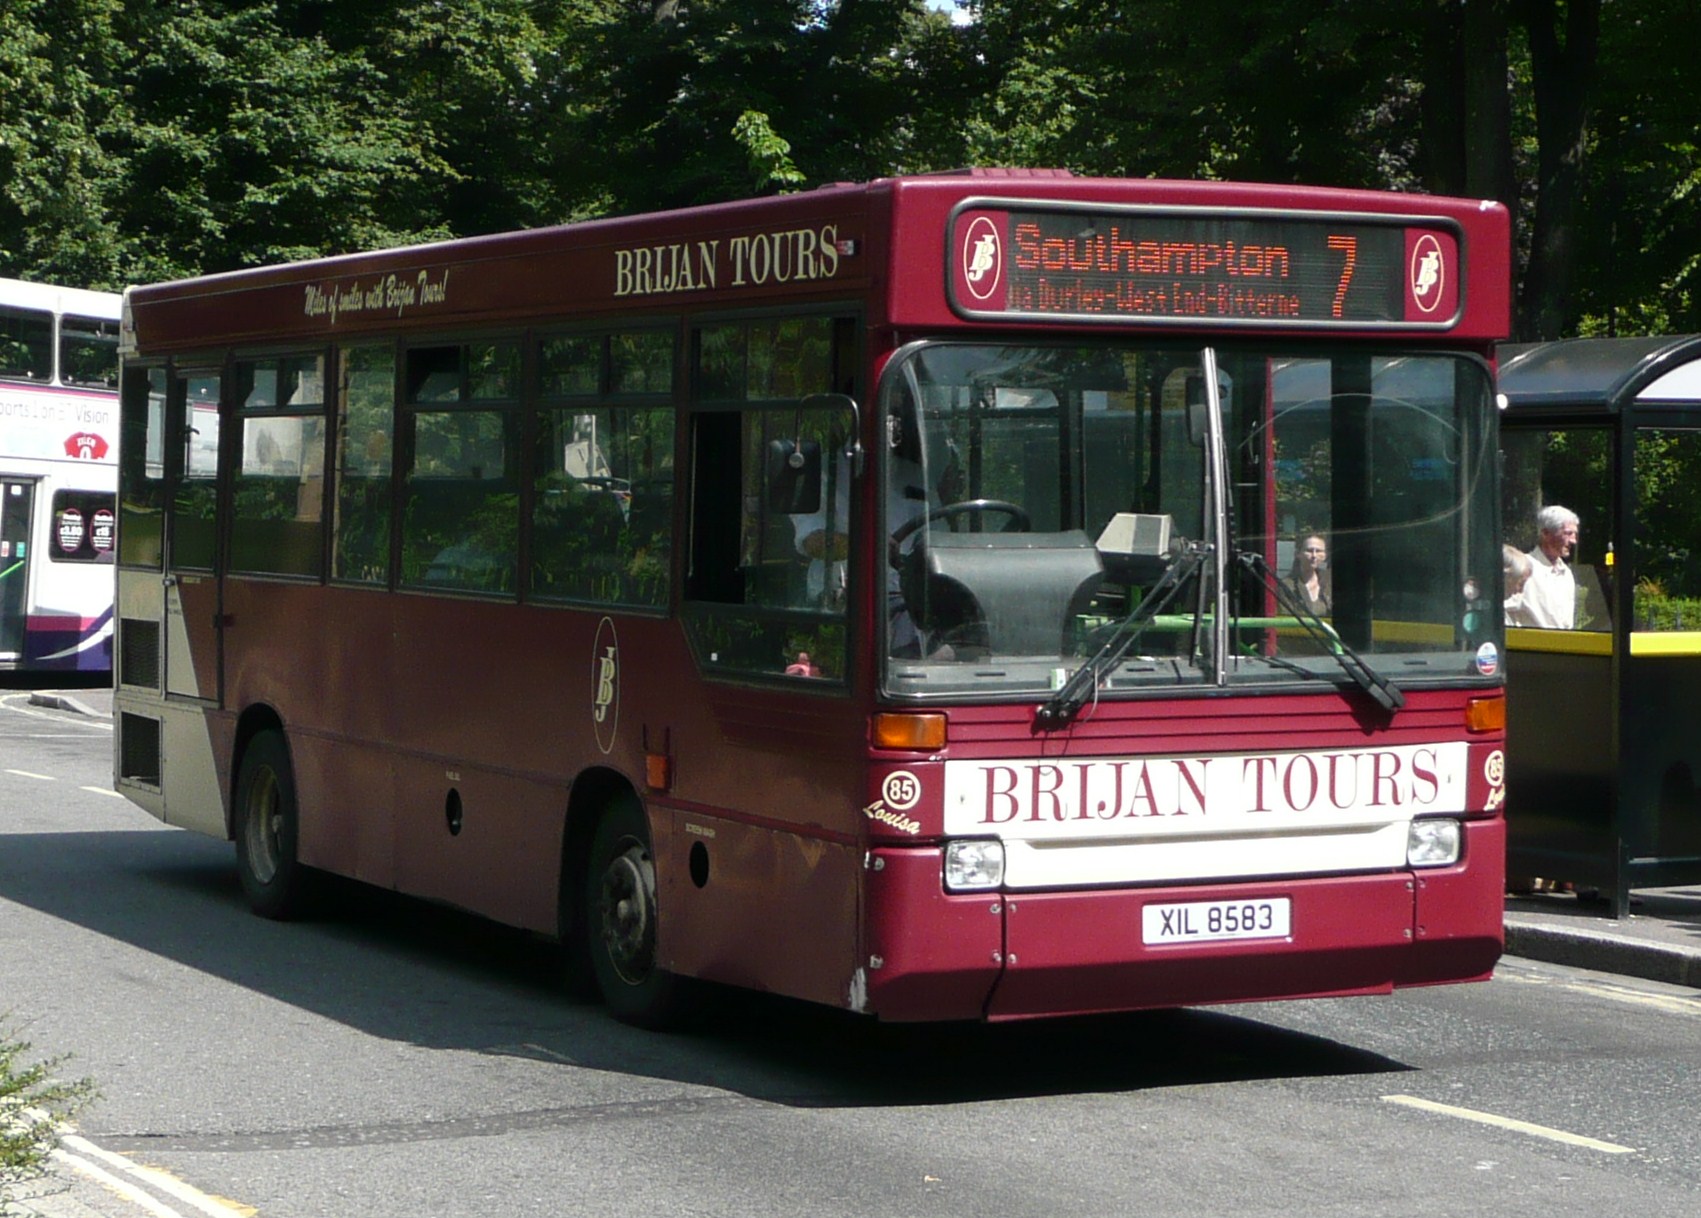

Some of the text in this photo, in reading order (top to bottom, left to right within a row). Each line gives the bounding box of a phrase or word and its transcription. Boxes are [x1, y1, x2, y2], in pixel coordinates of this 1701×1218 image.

[614, 224, 839, 295] BRIJAN TOURS
[1015, 223, 1356, 317] Southampton 7
[386, 273, 415, 318] Brijan
[889, 779, 914, 801] 85
[977, 749, 1439, 824] BRIJAN TOURS
[862, 799, 921, 835] Louisa
[1160, 904, 1273, 936] XIL 8583
